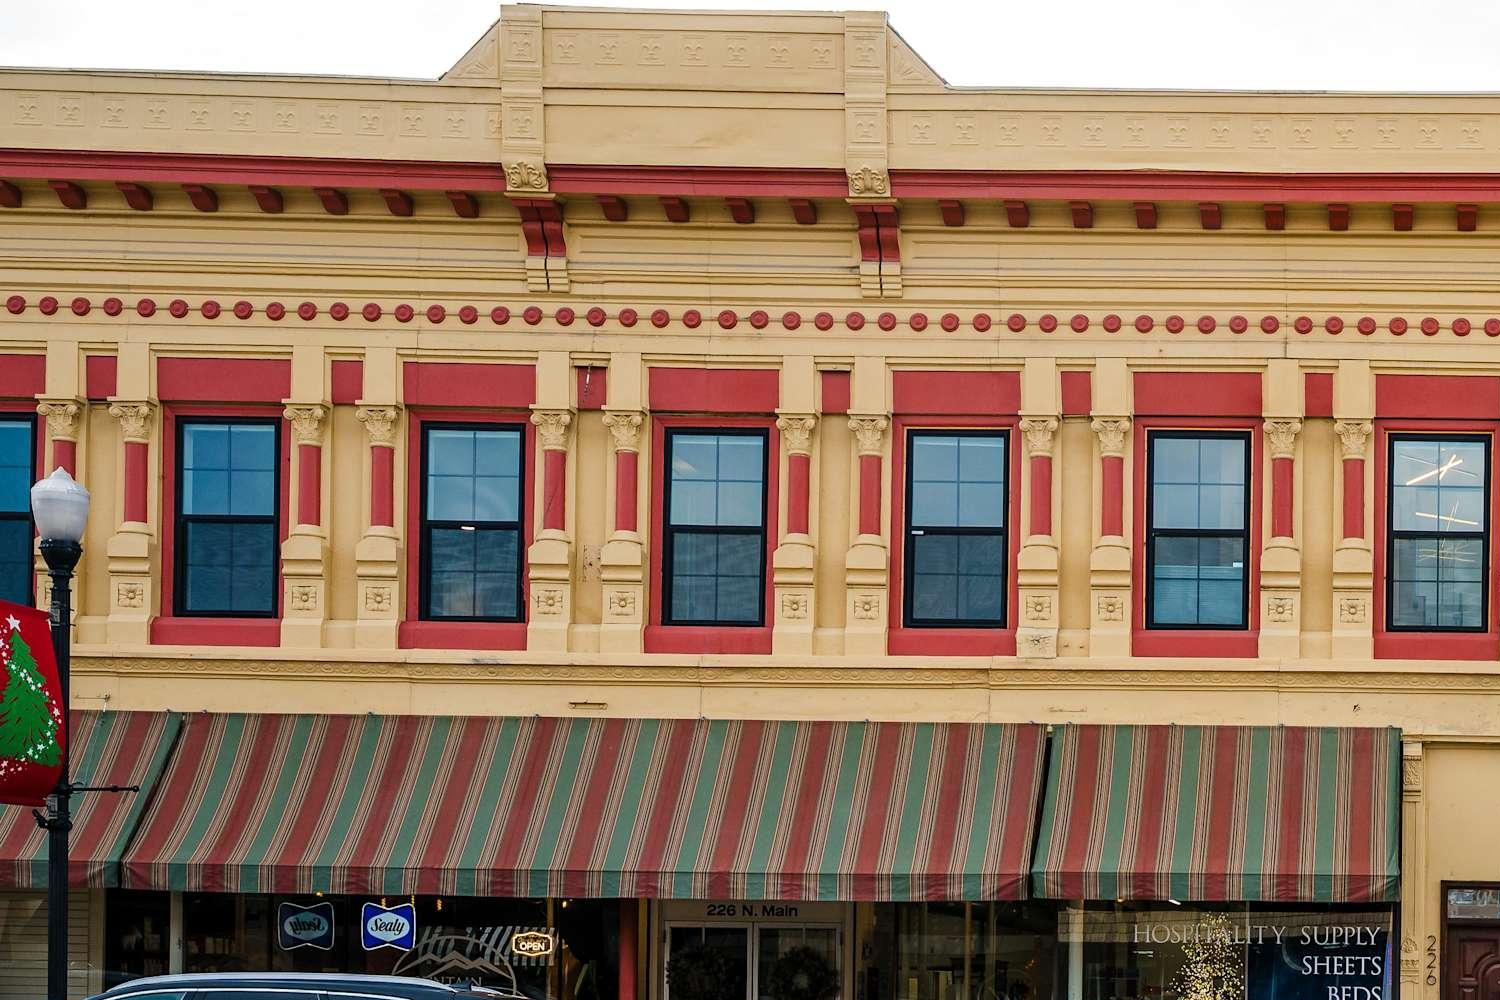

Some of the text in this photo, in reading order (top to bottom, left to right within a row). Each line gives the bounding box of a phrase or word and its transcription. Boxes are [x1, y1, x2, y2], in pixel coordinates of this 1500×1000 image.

[706, 904, 799, 917] 226 N. Main
[370, 917, 405, 934] Sealy
[1133, 924, 1381, 945] HOSPITALITY SUPPLY
[519, 942, 545, 951] OPEN
[1301, 956, 1382, 976] SHEETS
[1426, 935, 1437, 986] 226
